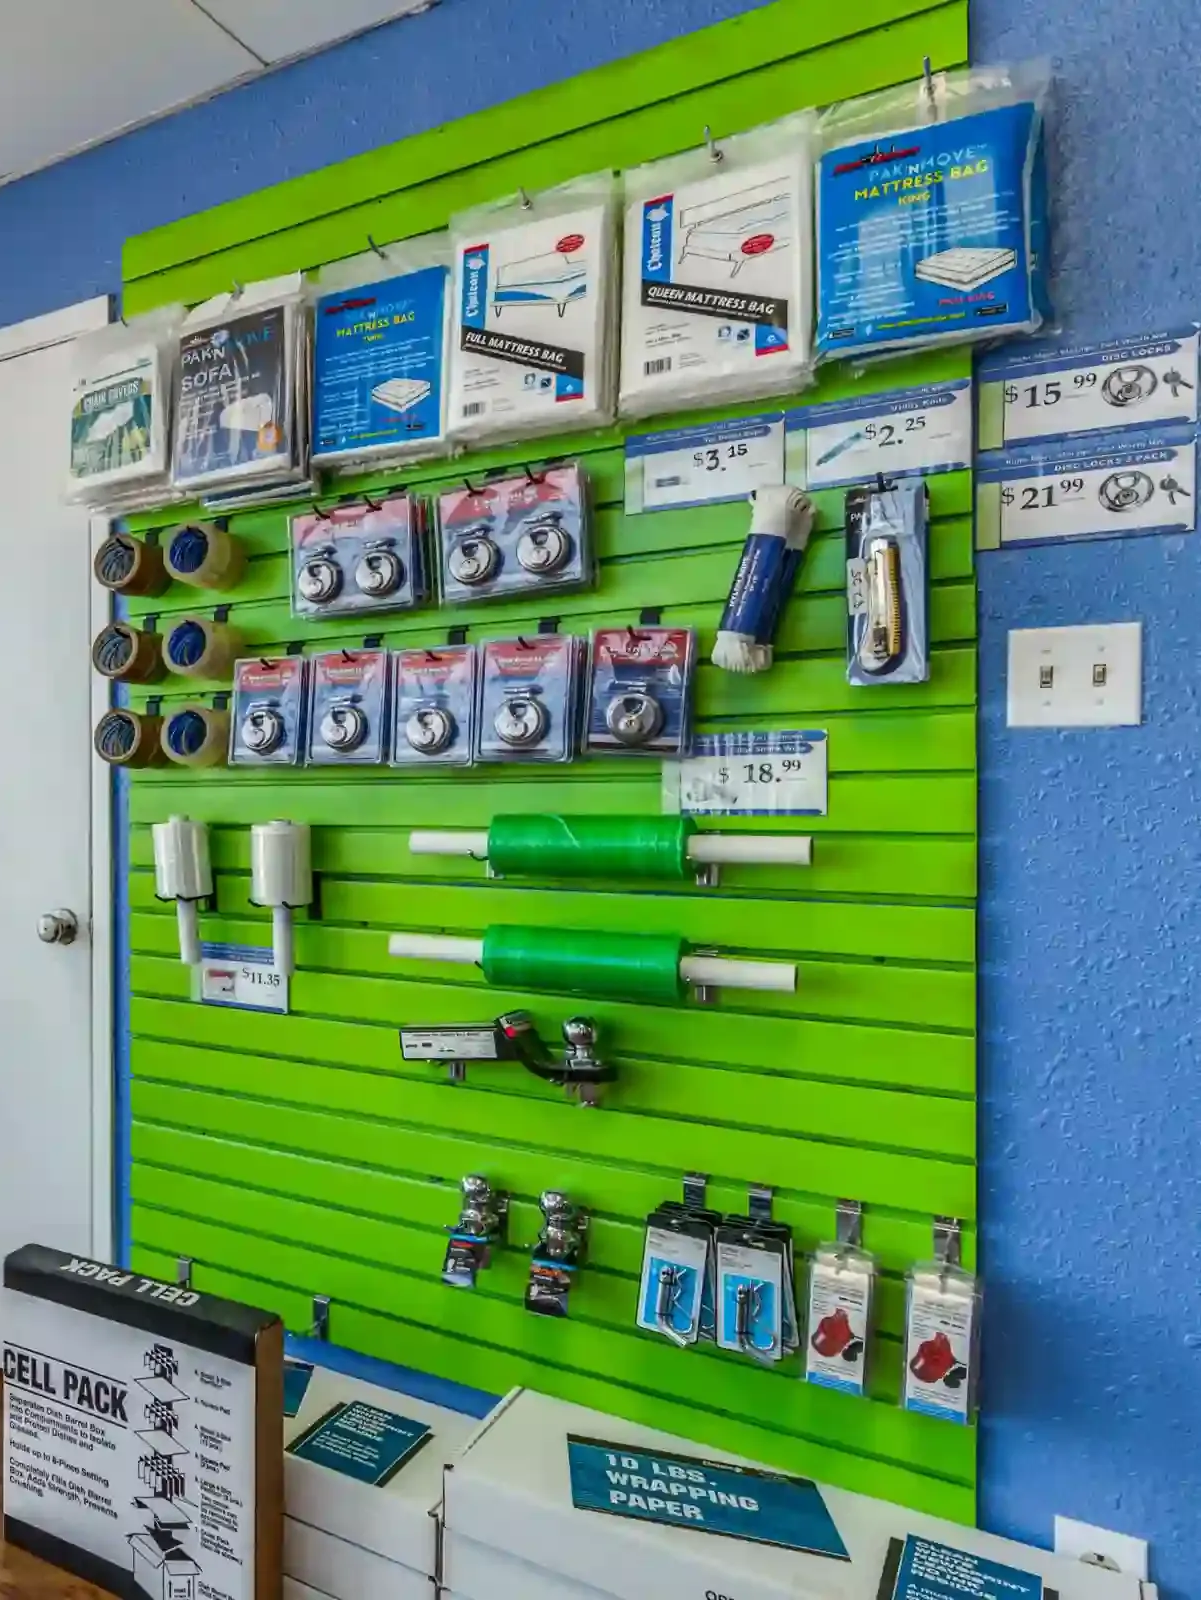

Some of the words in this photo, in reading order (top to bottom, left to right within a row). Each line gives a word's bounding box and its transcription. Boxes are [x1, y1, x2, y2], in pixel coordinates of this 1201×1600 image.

[854, 170, 944, 202] MATTRESS
[950, 159, 990, 180] BAG
[648, 286, 685, 300] QUEEN
[685, 291, 747, 310] MATTRESS
[748, 300, 776, 315] BAG
[336, 316, 390, 338] MATTRESS
[465, 332, 487, 345] FULL
[488, 338, 541, 357] MATTRESS
[541, 349, 565, 363] BAG
[1101, 352, 1128, 362] DISC
[1132, 344, 1172, 358] LOCKS
[181, 363, 232, 392] SOFA
[1054, 461, 1081, 472] DISC
[1084, 457, 1123, 468] LOCKS
[1134, 452, 1168, 463] PACK
[59, 1257, 135, 1288] PACK
[134, 1279, 202, 1308] CELL
[3, 1348, 56, 1395] CELL
[63, 1368, 129, 1422] PACK
[89, 1423, 106, 1436] Box
[652, 1463, 719, 1487] LBS.
[606, 1471, 760, 1512] WRAPPING
[609, 1490, 705, 1520] PAPER
[915, 1541, 978, 1565] CLEAN
[910, 1568, 997, 1600] RESIDUE
[912, 1563, 940, 1576] NO
[945, 1573, 981, 1590] INK
[914, 1557, 985, 1585] LEAVES
[914, 1551, 1031, 1592] NEWSPRINT
